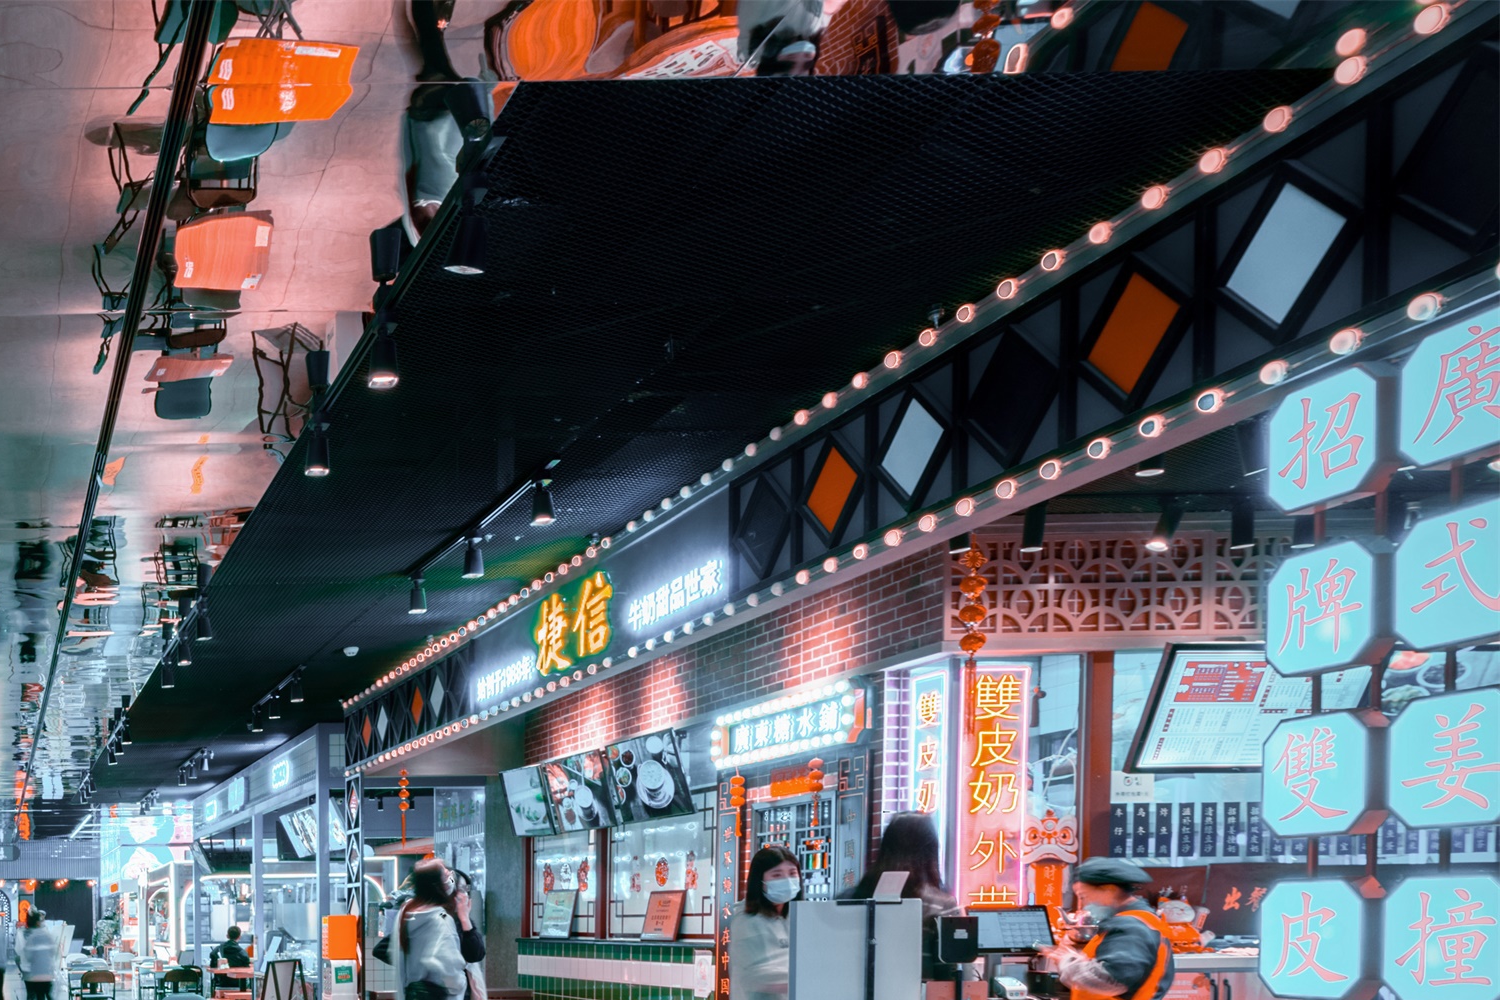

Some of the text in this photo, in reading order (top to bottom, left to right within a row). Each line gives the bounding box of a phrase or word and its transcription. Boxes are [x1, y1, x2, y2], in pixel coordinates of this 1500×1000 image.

[534, 571, 613, 677] 捷信
[628, 560, 722, 631] 牛奶甜品世家
[916, 690, 941, 813] 雙皮奶
